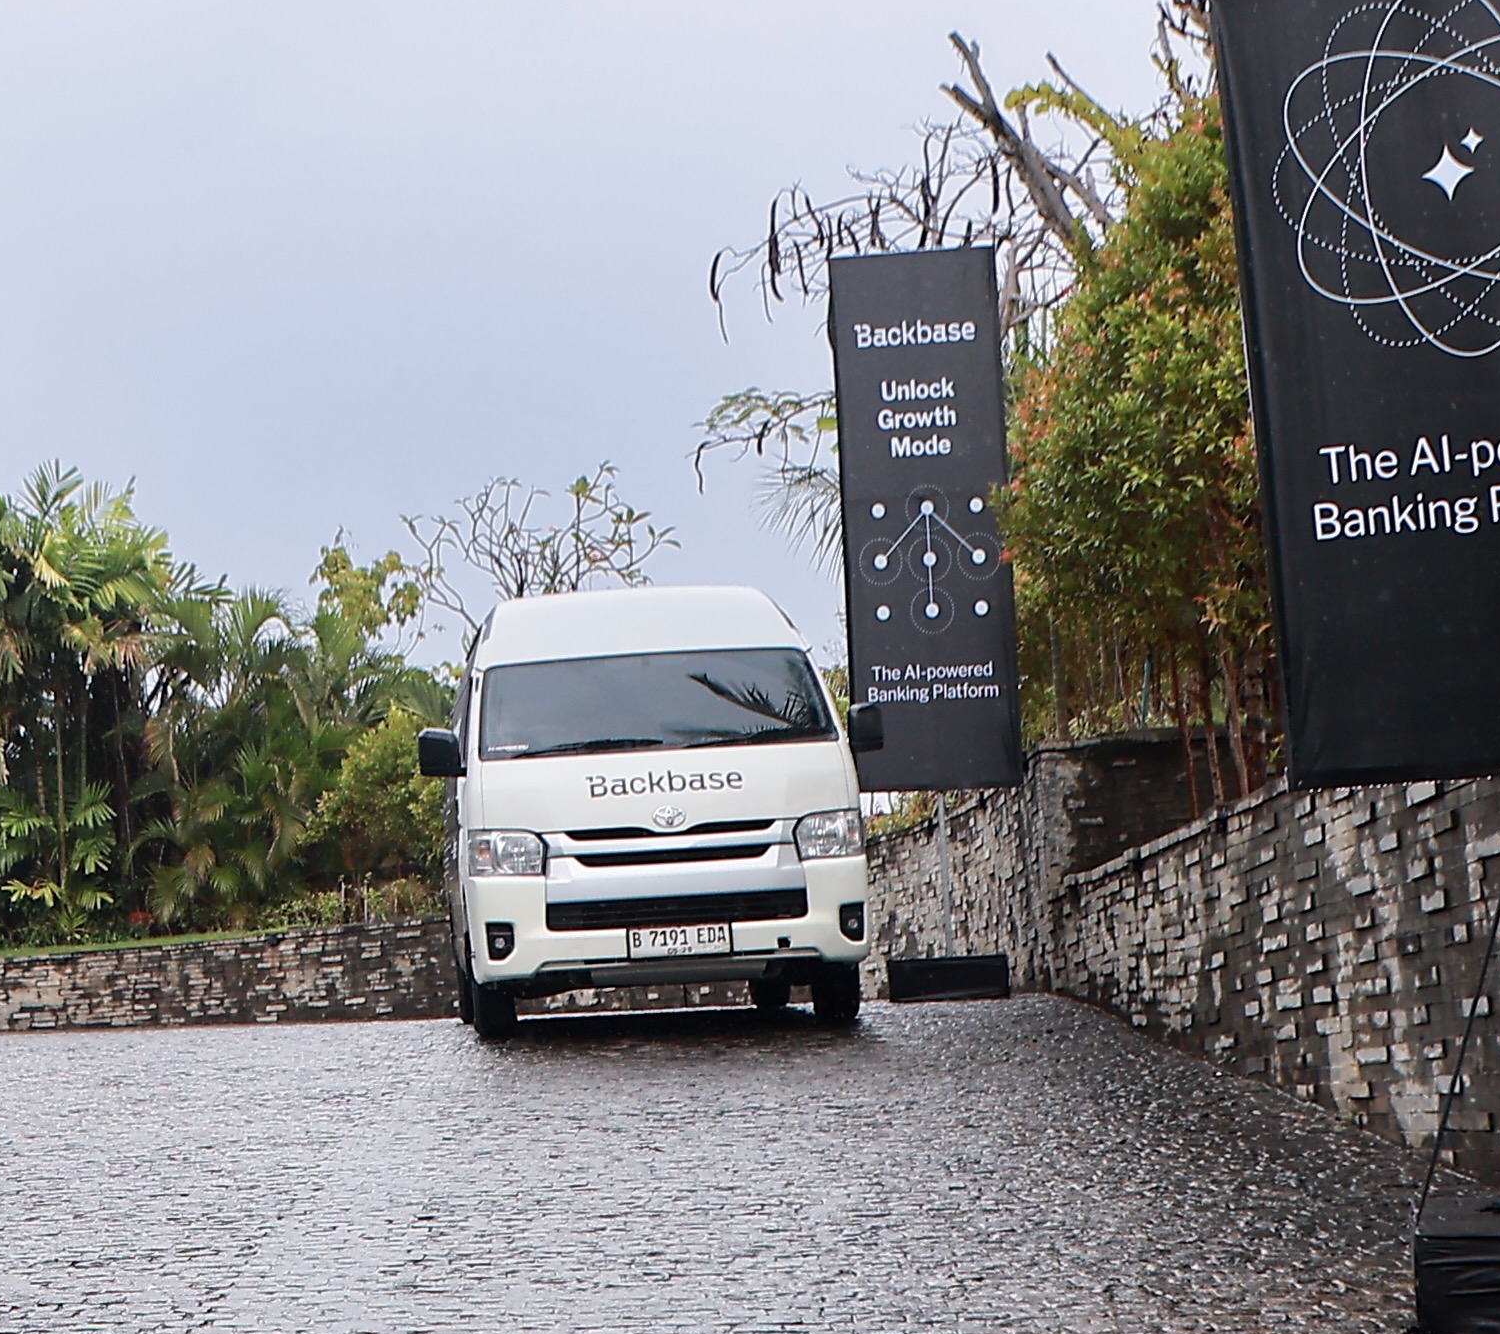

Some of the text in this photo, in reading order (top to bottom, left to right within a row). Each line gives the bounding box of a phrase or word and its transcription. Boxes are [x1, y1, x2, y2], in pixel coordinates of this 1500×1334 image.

[853, 319, 977, 349] Backbase
[880, 376, 956, 402] Unlock
[877, 405, 957, 431] Growth
[890, 433, 952, 458] Mode
[1318, 442, 1399, 485] The
[1312, 491, 1480, 541] Banking
[870, 660, 994, 682] The AI-powered
[867, 681, 1000, 704] Banking Platform
[585, 769, 744, 799] Backbase
[631, 925, 727, 948] B 7191 EDA
